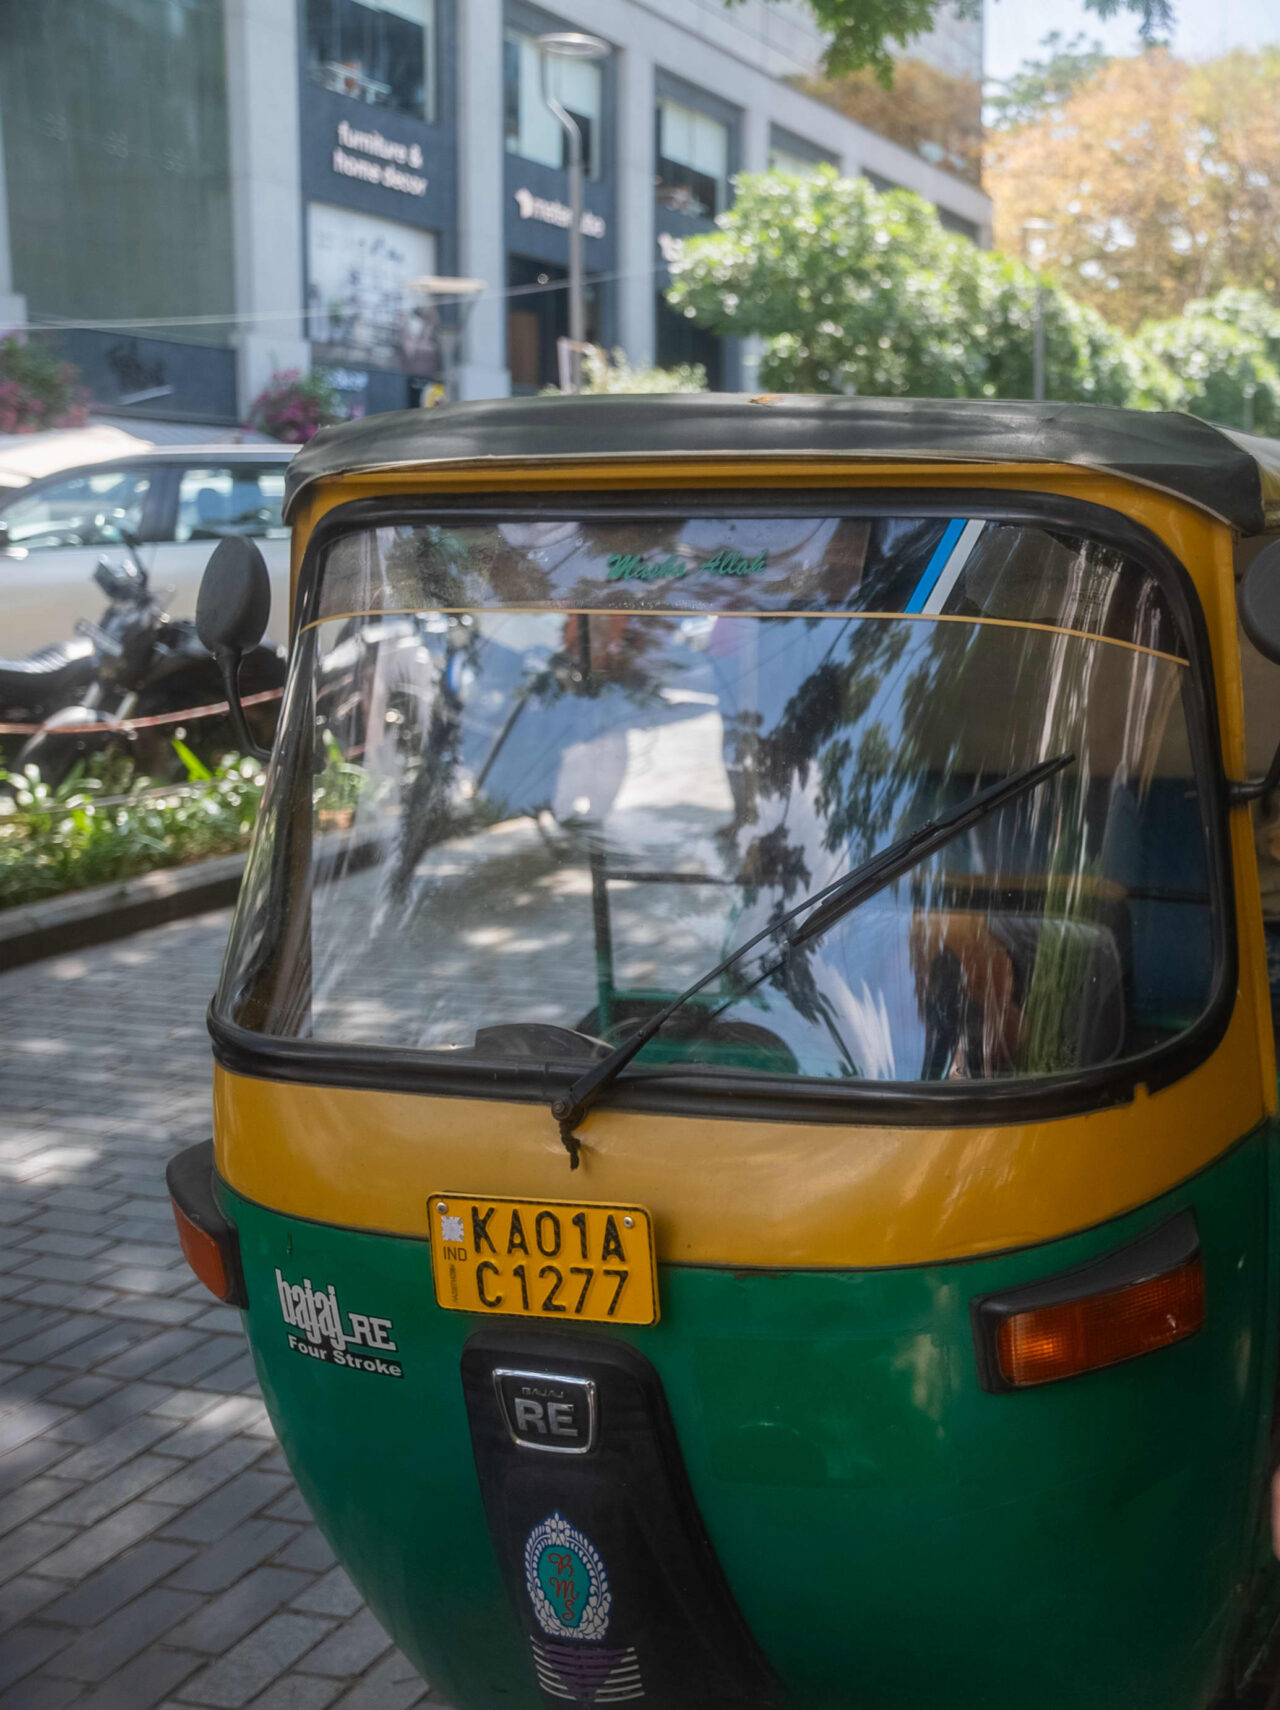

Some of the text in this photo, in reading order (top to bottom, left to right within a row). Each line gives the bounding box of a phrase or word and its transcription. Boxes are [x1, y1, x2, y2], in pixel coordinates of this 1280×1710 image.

[443, 1246, 468, 1262] IND
[471, 1205, 626, 1263] KA01A
[475, 1260, 629, 1316] C1277
[287, 1334, 402, 1377] Four Stroke
[514, 1397, 578, 1437] RE
